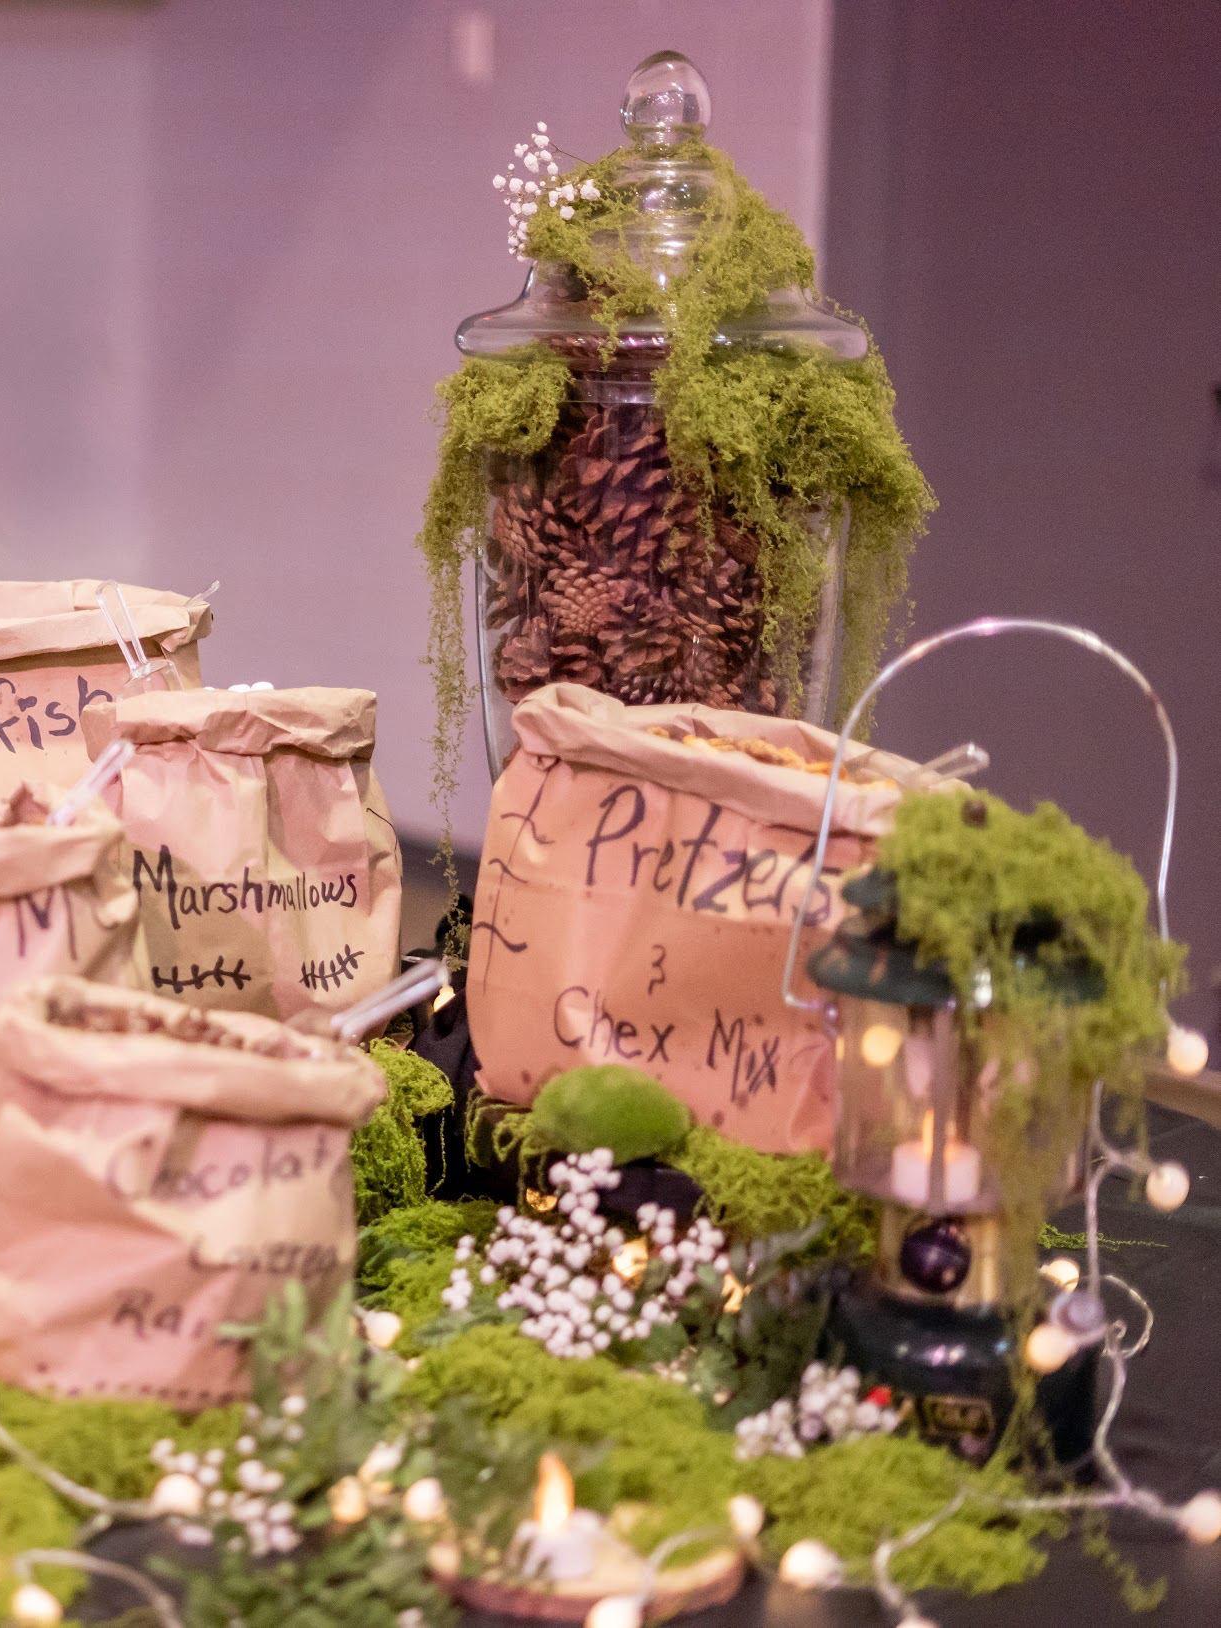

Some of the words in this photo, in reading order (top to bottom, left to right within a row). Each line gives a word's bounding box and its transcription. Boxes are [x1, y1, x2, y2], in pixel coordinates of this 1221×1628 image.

[133, 844, 357, 930] Marshmallows
[586, 785, 844, 927] Pretzels
[553, 985, 675, 1063] Chex
[706, 1007, 780, 1102] Mix
